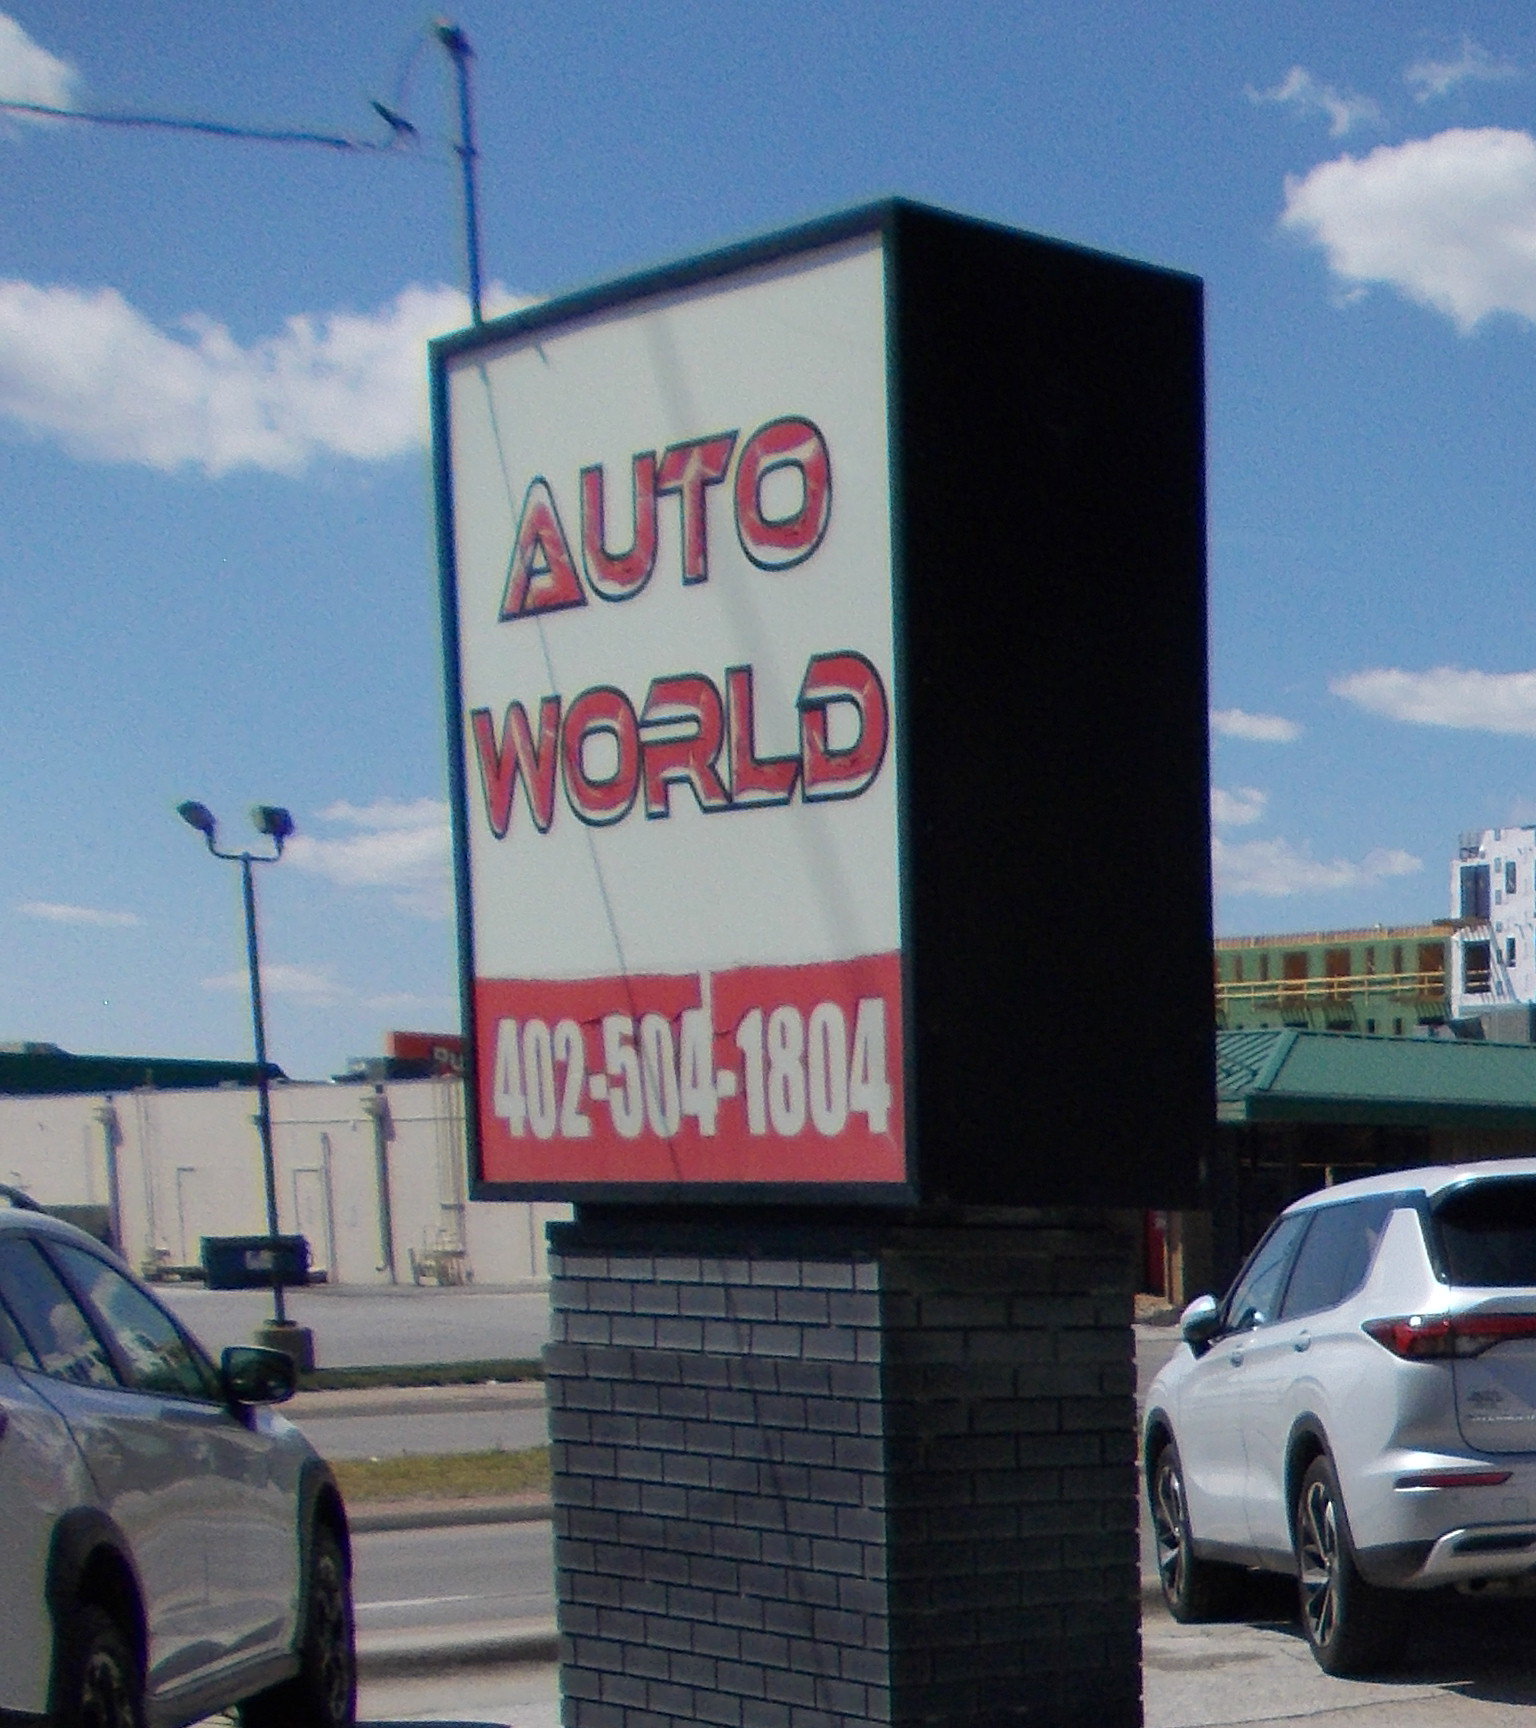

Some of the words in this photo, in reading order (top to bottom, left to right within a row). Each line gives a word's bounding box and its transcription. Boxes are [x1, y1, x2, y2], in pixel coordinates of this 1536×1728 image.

[497, 414, 832, 621] AUTO
[470, 650, 889, 840] WORLD
[493, 998, 893, 1140] 402-504-1804
